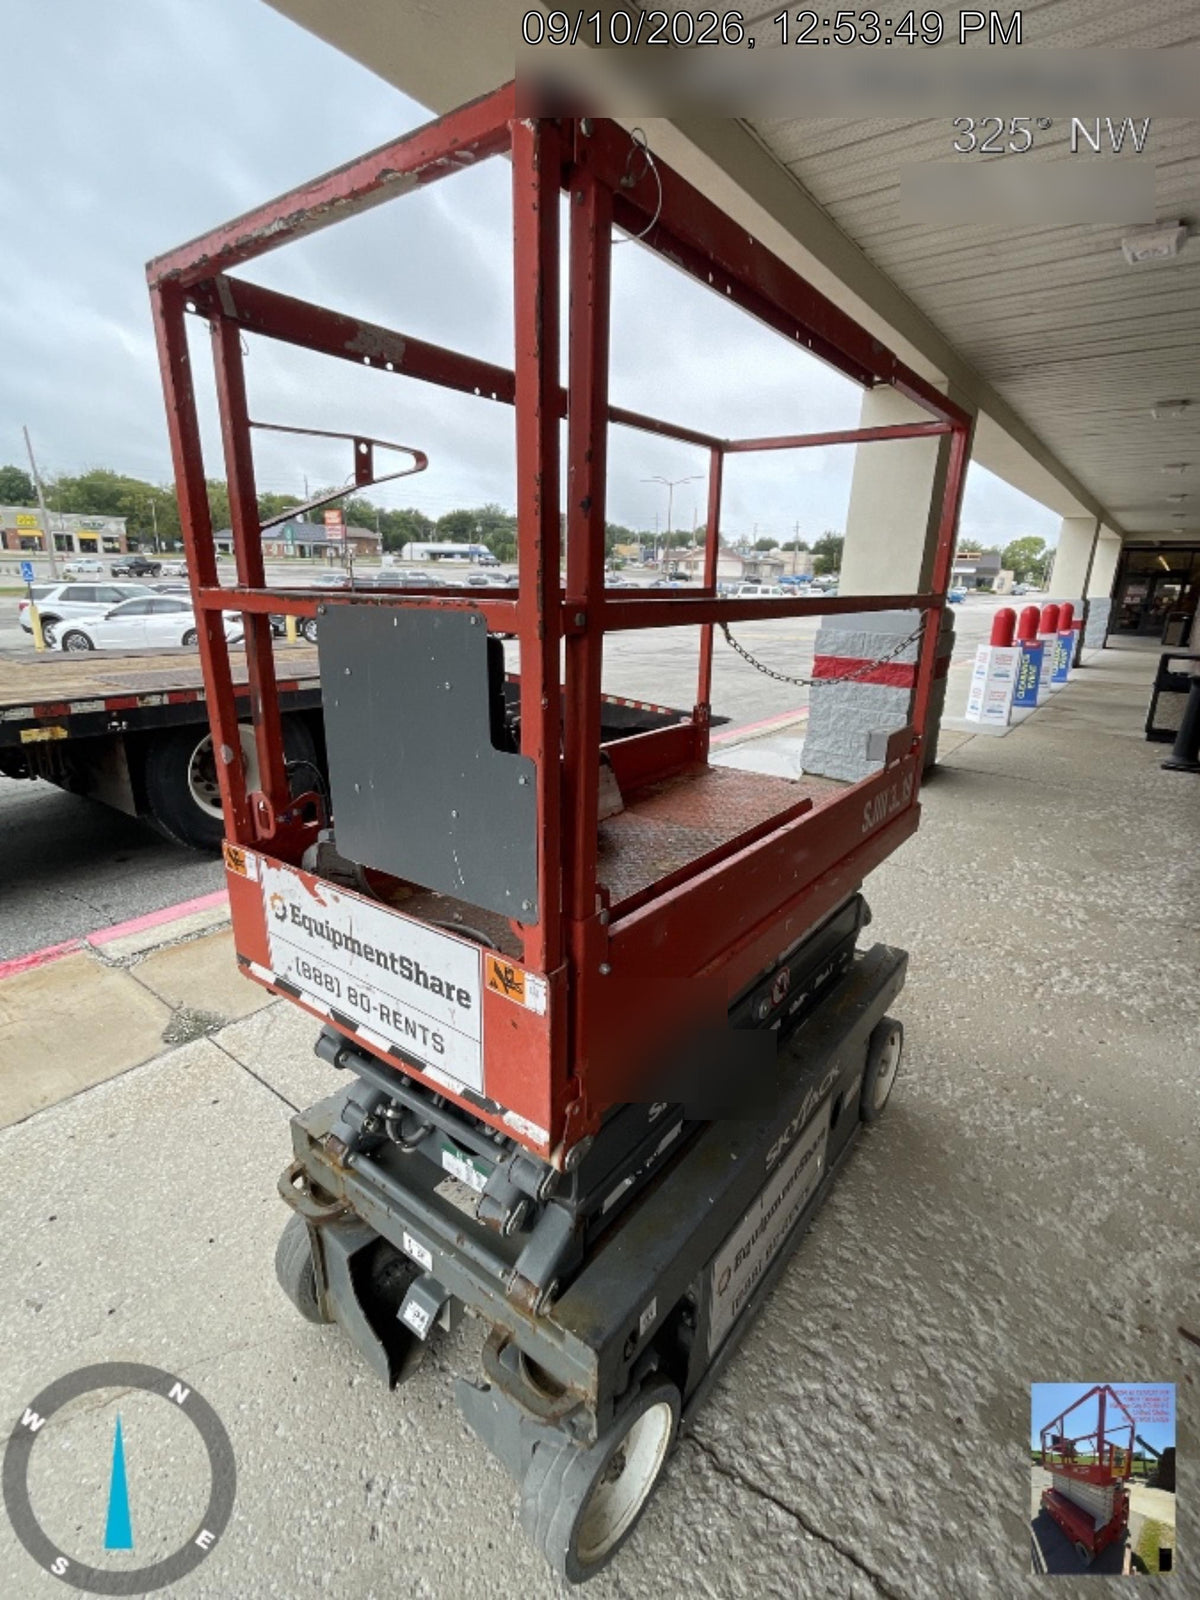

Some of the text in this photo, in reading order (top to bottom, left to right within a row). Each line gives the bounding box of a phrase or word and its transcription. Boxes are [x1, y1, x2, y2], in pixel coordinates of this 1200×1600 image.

[289, 901, 473, 1011] EquipmentShare
[296, 955, 446, 1056] (888) 80-RENTS
